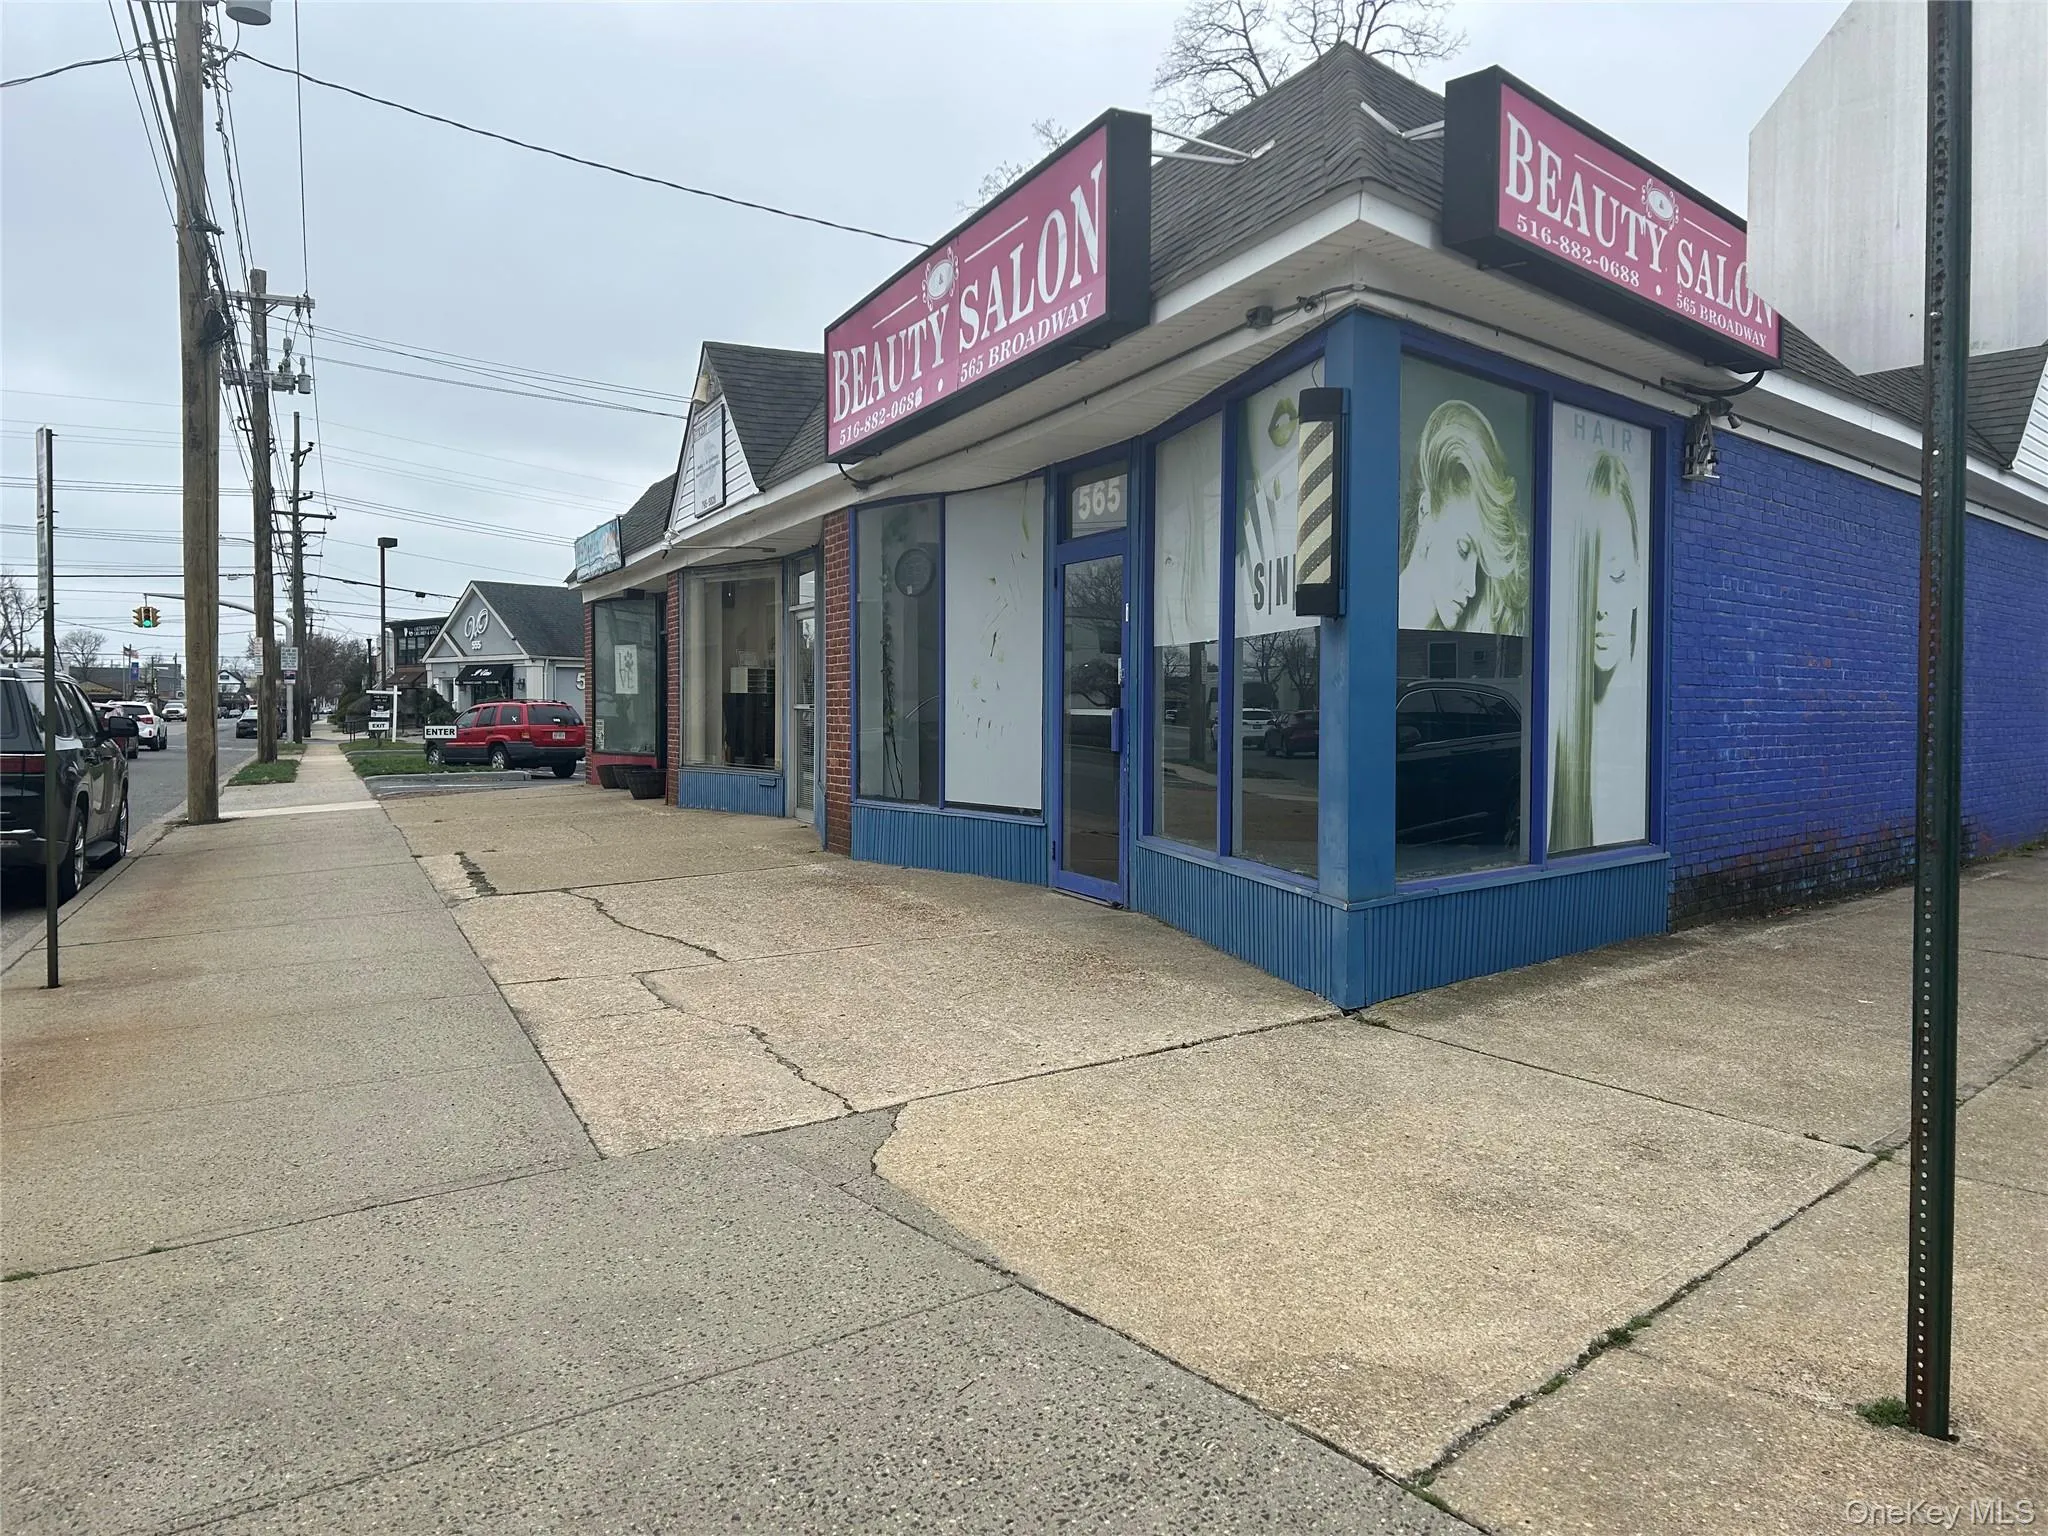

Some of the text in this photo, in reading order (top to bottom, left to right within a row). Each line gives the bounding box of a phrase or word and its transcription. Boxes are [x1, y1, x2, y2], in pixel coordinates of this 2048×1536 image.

[1505, 112, 1668, 274] BEAUTY
[832, 159, 1104, 423] BEAUTY SALON
[1517, 215, 1768, 349] 516-882-0688 565 BROADWAY
[960, 353, 984, 384] 565
[988, 291, 1094, 370] BROADWAY
[1572, 412, 1633, 454] HAIR
[1078, 477, 1121, 521] 565
[425, 728, 455, 736] ENTER
